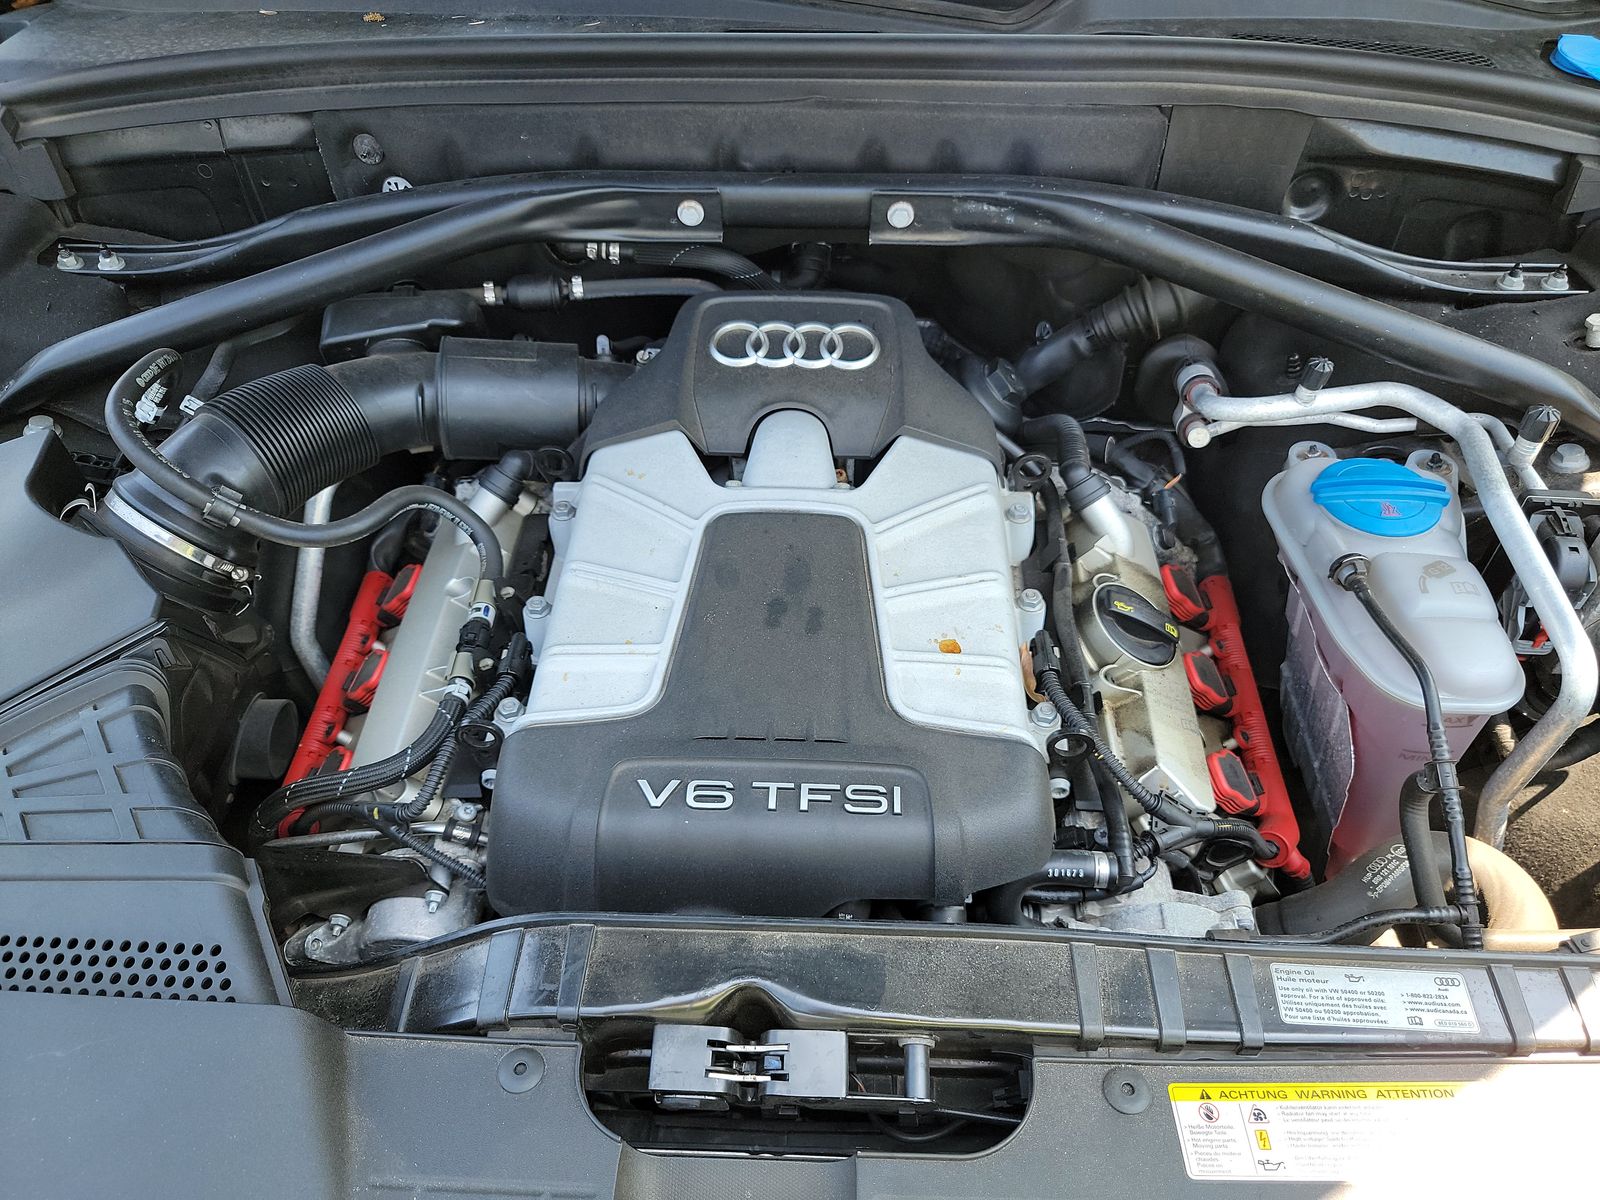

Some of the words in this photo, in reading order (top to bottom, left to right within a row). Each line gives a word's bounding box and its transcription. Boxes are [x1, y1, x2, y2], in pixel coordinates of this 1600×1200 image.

[637, 779, 735, 810] V6
[751, 781, 902, 815] TFSI
[1274, 968, 1302, 976] Engine
[1344, 996, 1372, 1004] approved
[1304, 1001, 1340, 1009] uniquement
[1219, 1090, 1288, 1100] ACHTUNG
[1294, 1089, 1367, 1099] WARNING
[1376, 1088, 1455, 1099] ATTENTION
